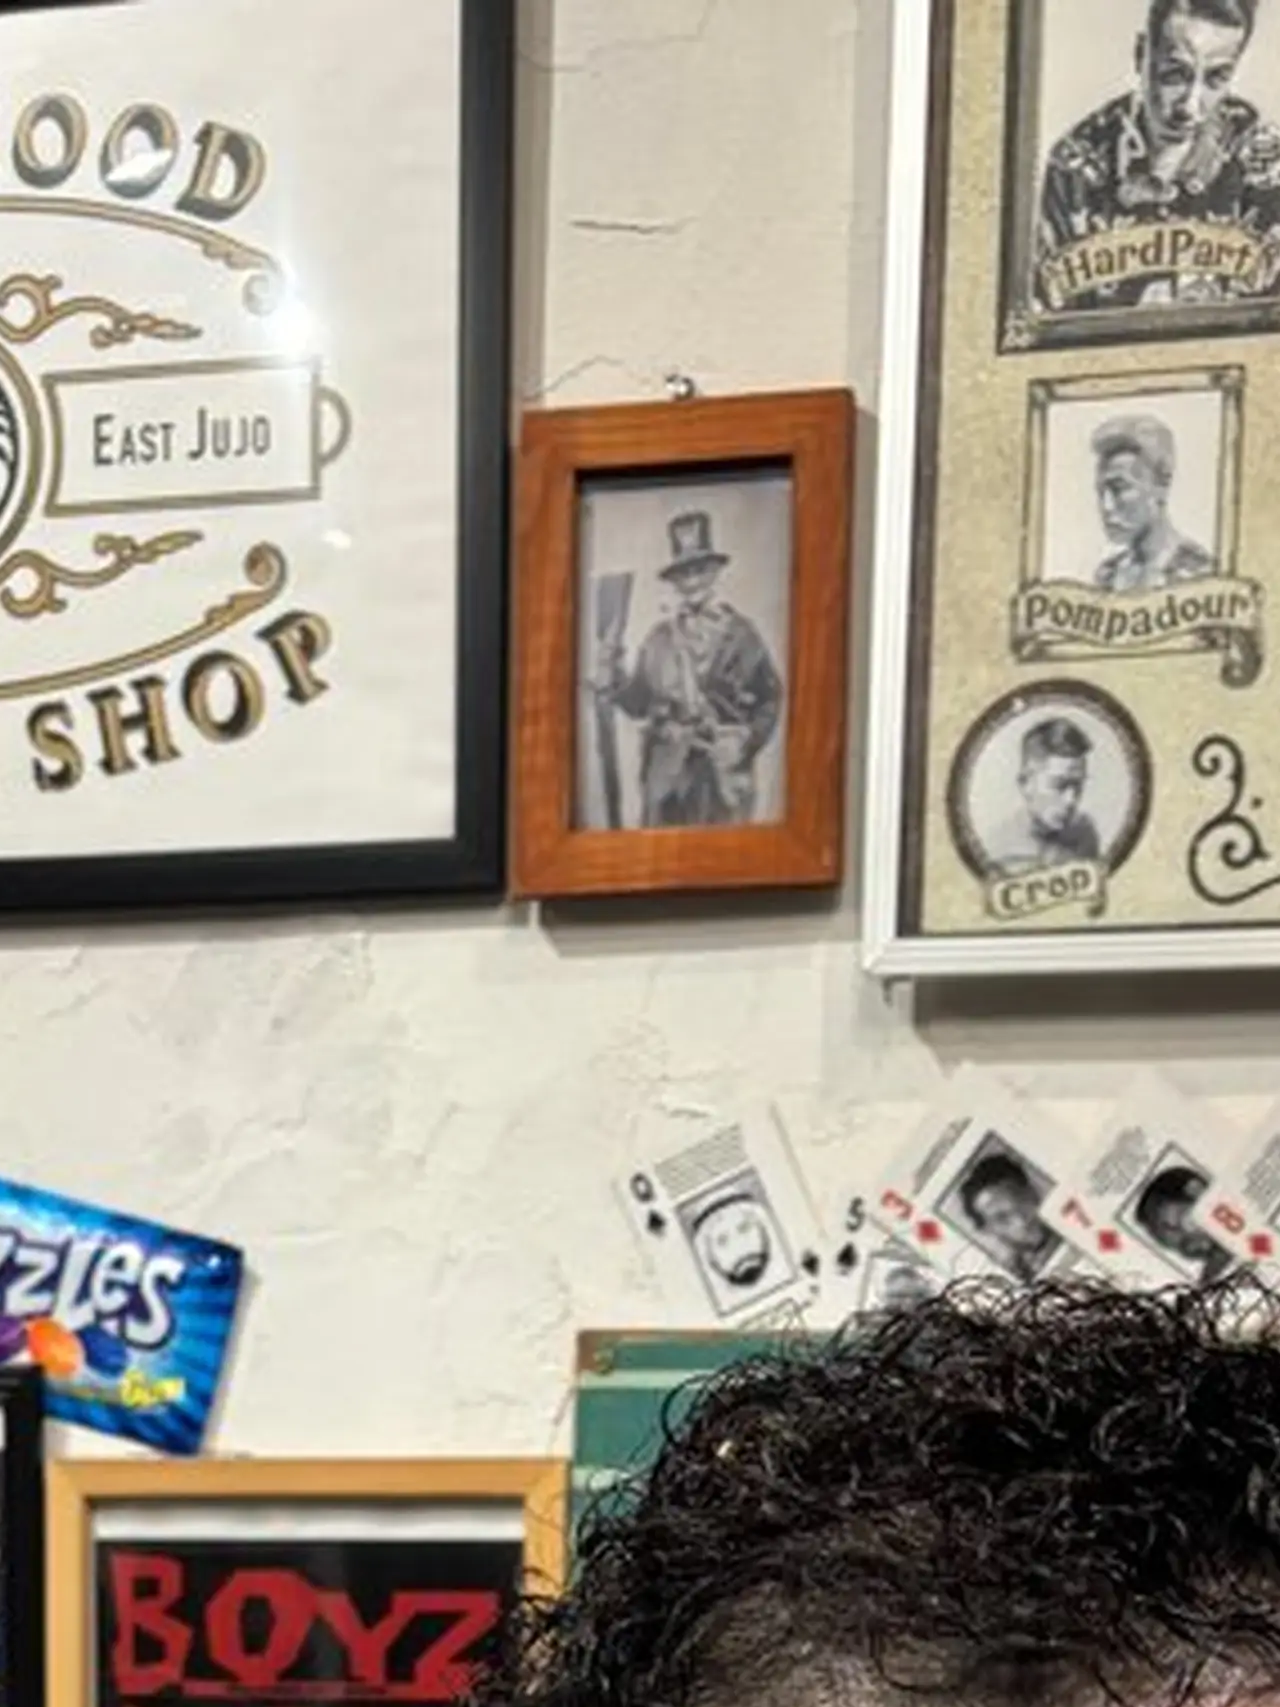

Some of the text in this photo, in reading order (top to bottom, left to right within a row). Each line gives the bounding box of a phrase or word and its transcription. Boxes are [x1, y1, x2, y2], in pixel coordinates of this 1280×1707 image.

[1025, 590, 1251, 641] Pompadour
[30, 608, 333, 793] SHOP
[109, 1551, 501, 1699] BOYZ
